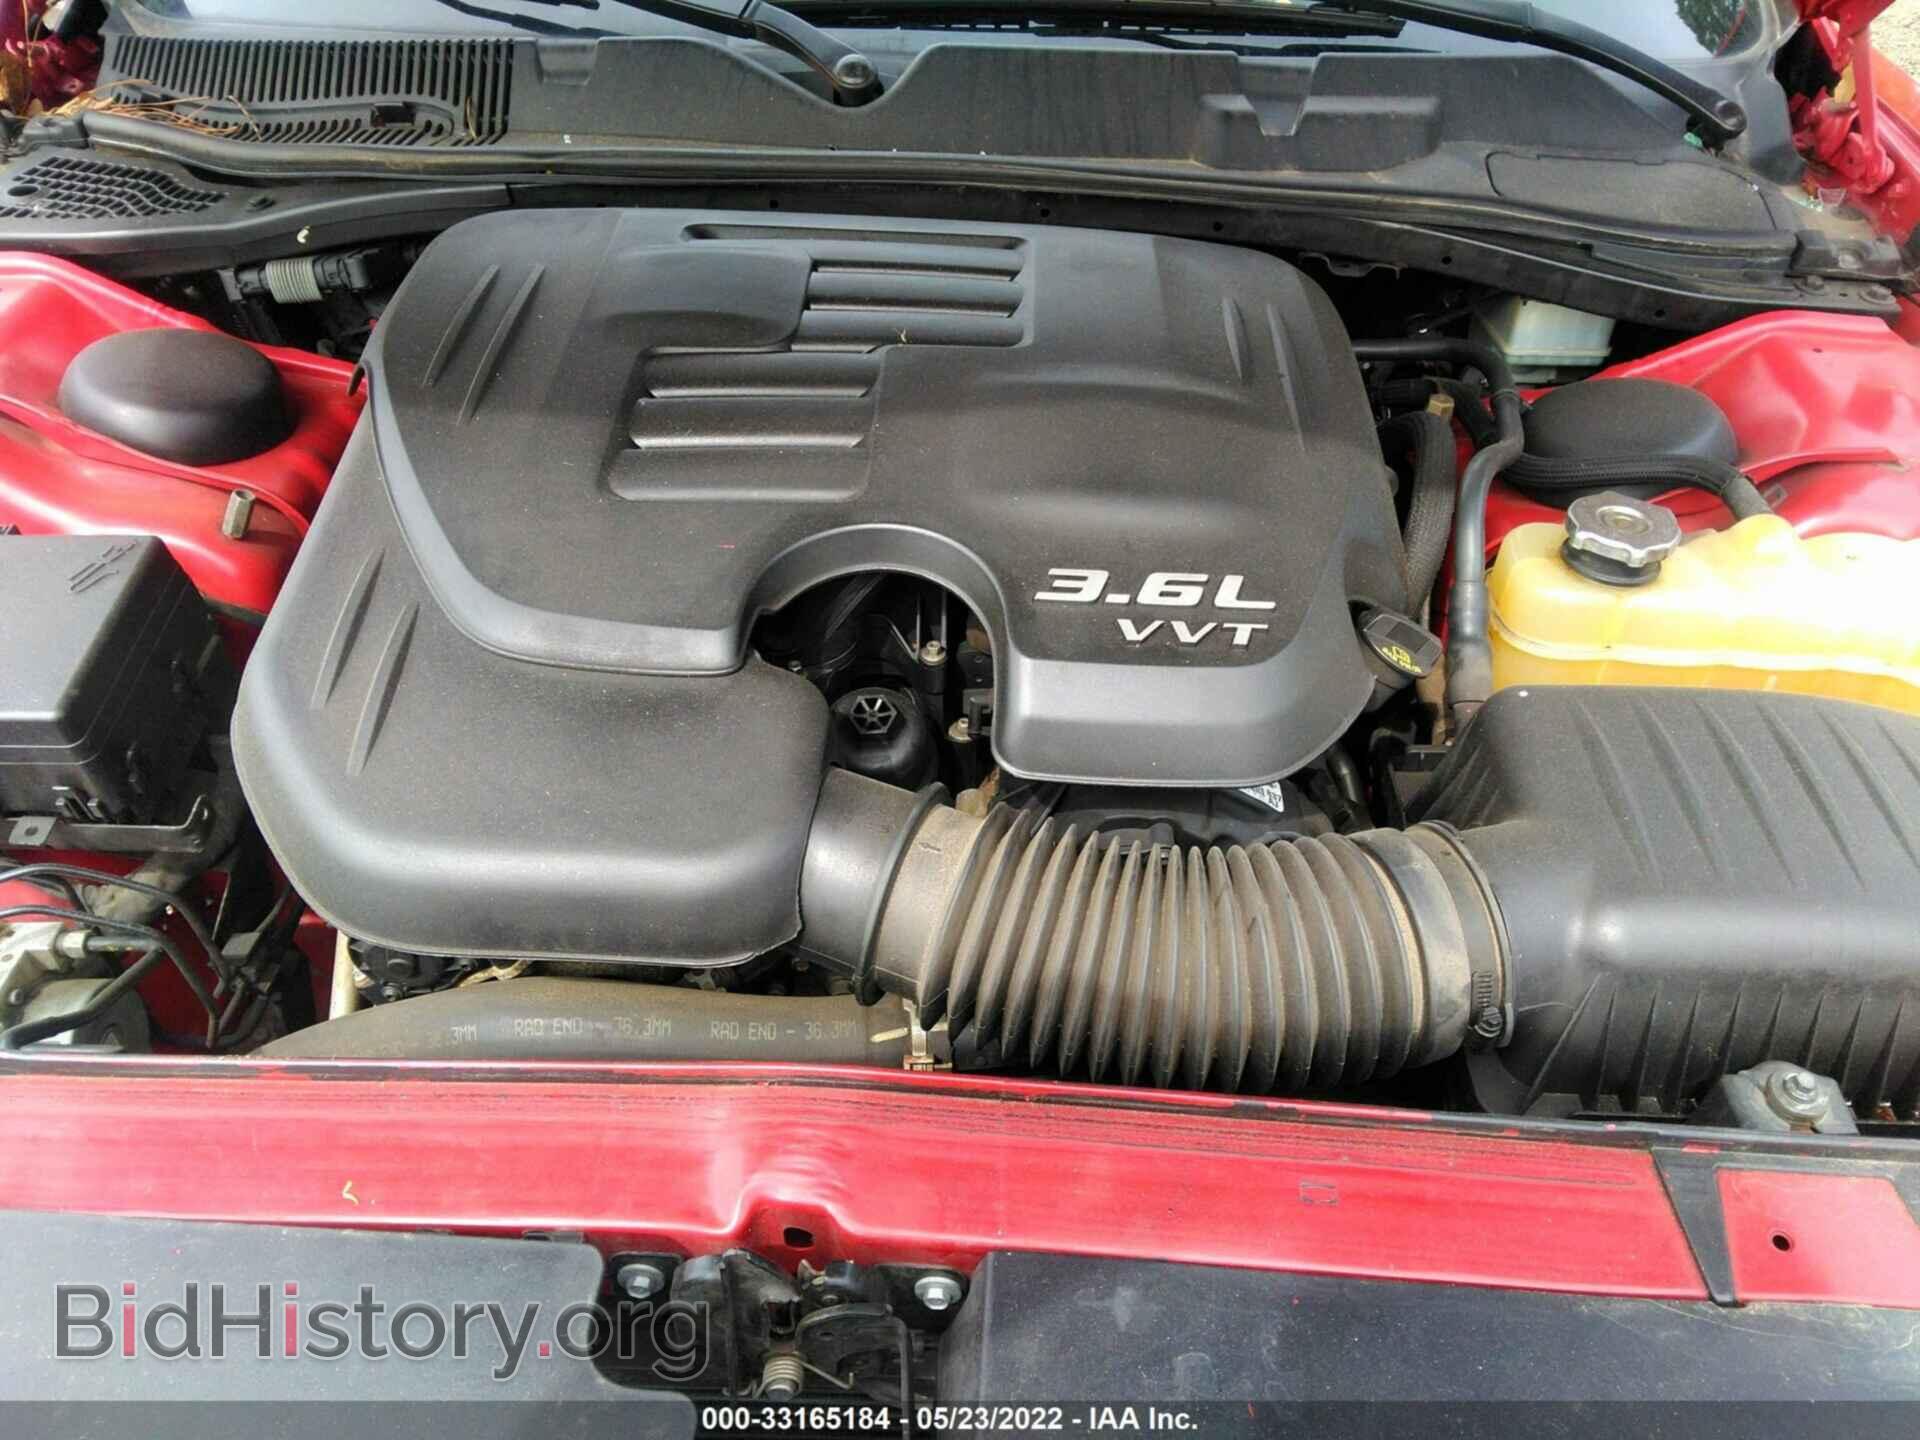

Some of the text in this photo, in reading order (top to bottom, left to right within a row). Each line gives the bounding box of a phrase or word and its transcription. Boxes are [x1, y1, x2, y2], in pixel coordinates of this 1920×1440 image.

[1034, 567, 1276, 610] 3.6L
[1116, 618, 1269, 647] VVT
[514, 1018, 544, 1036] RAD
[553, 1017, 583, 1035] END
[710, 1021, 739, 1040] RAD
[749, 1022, 777, 1040] END
